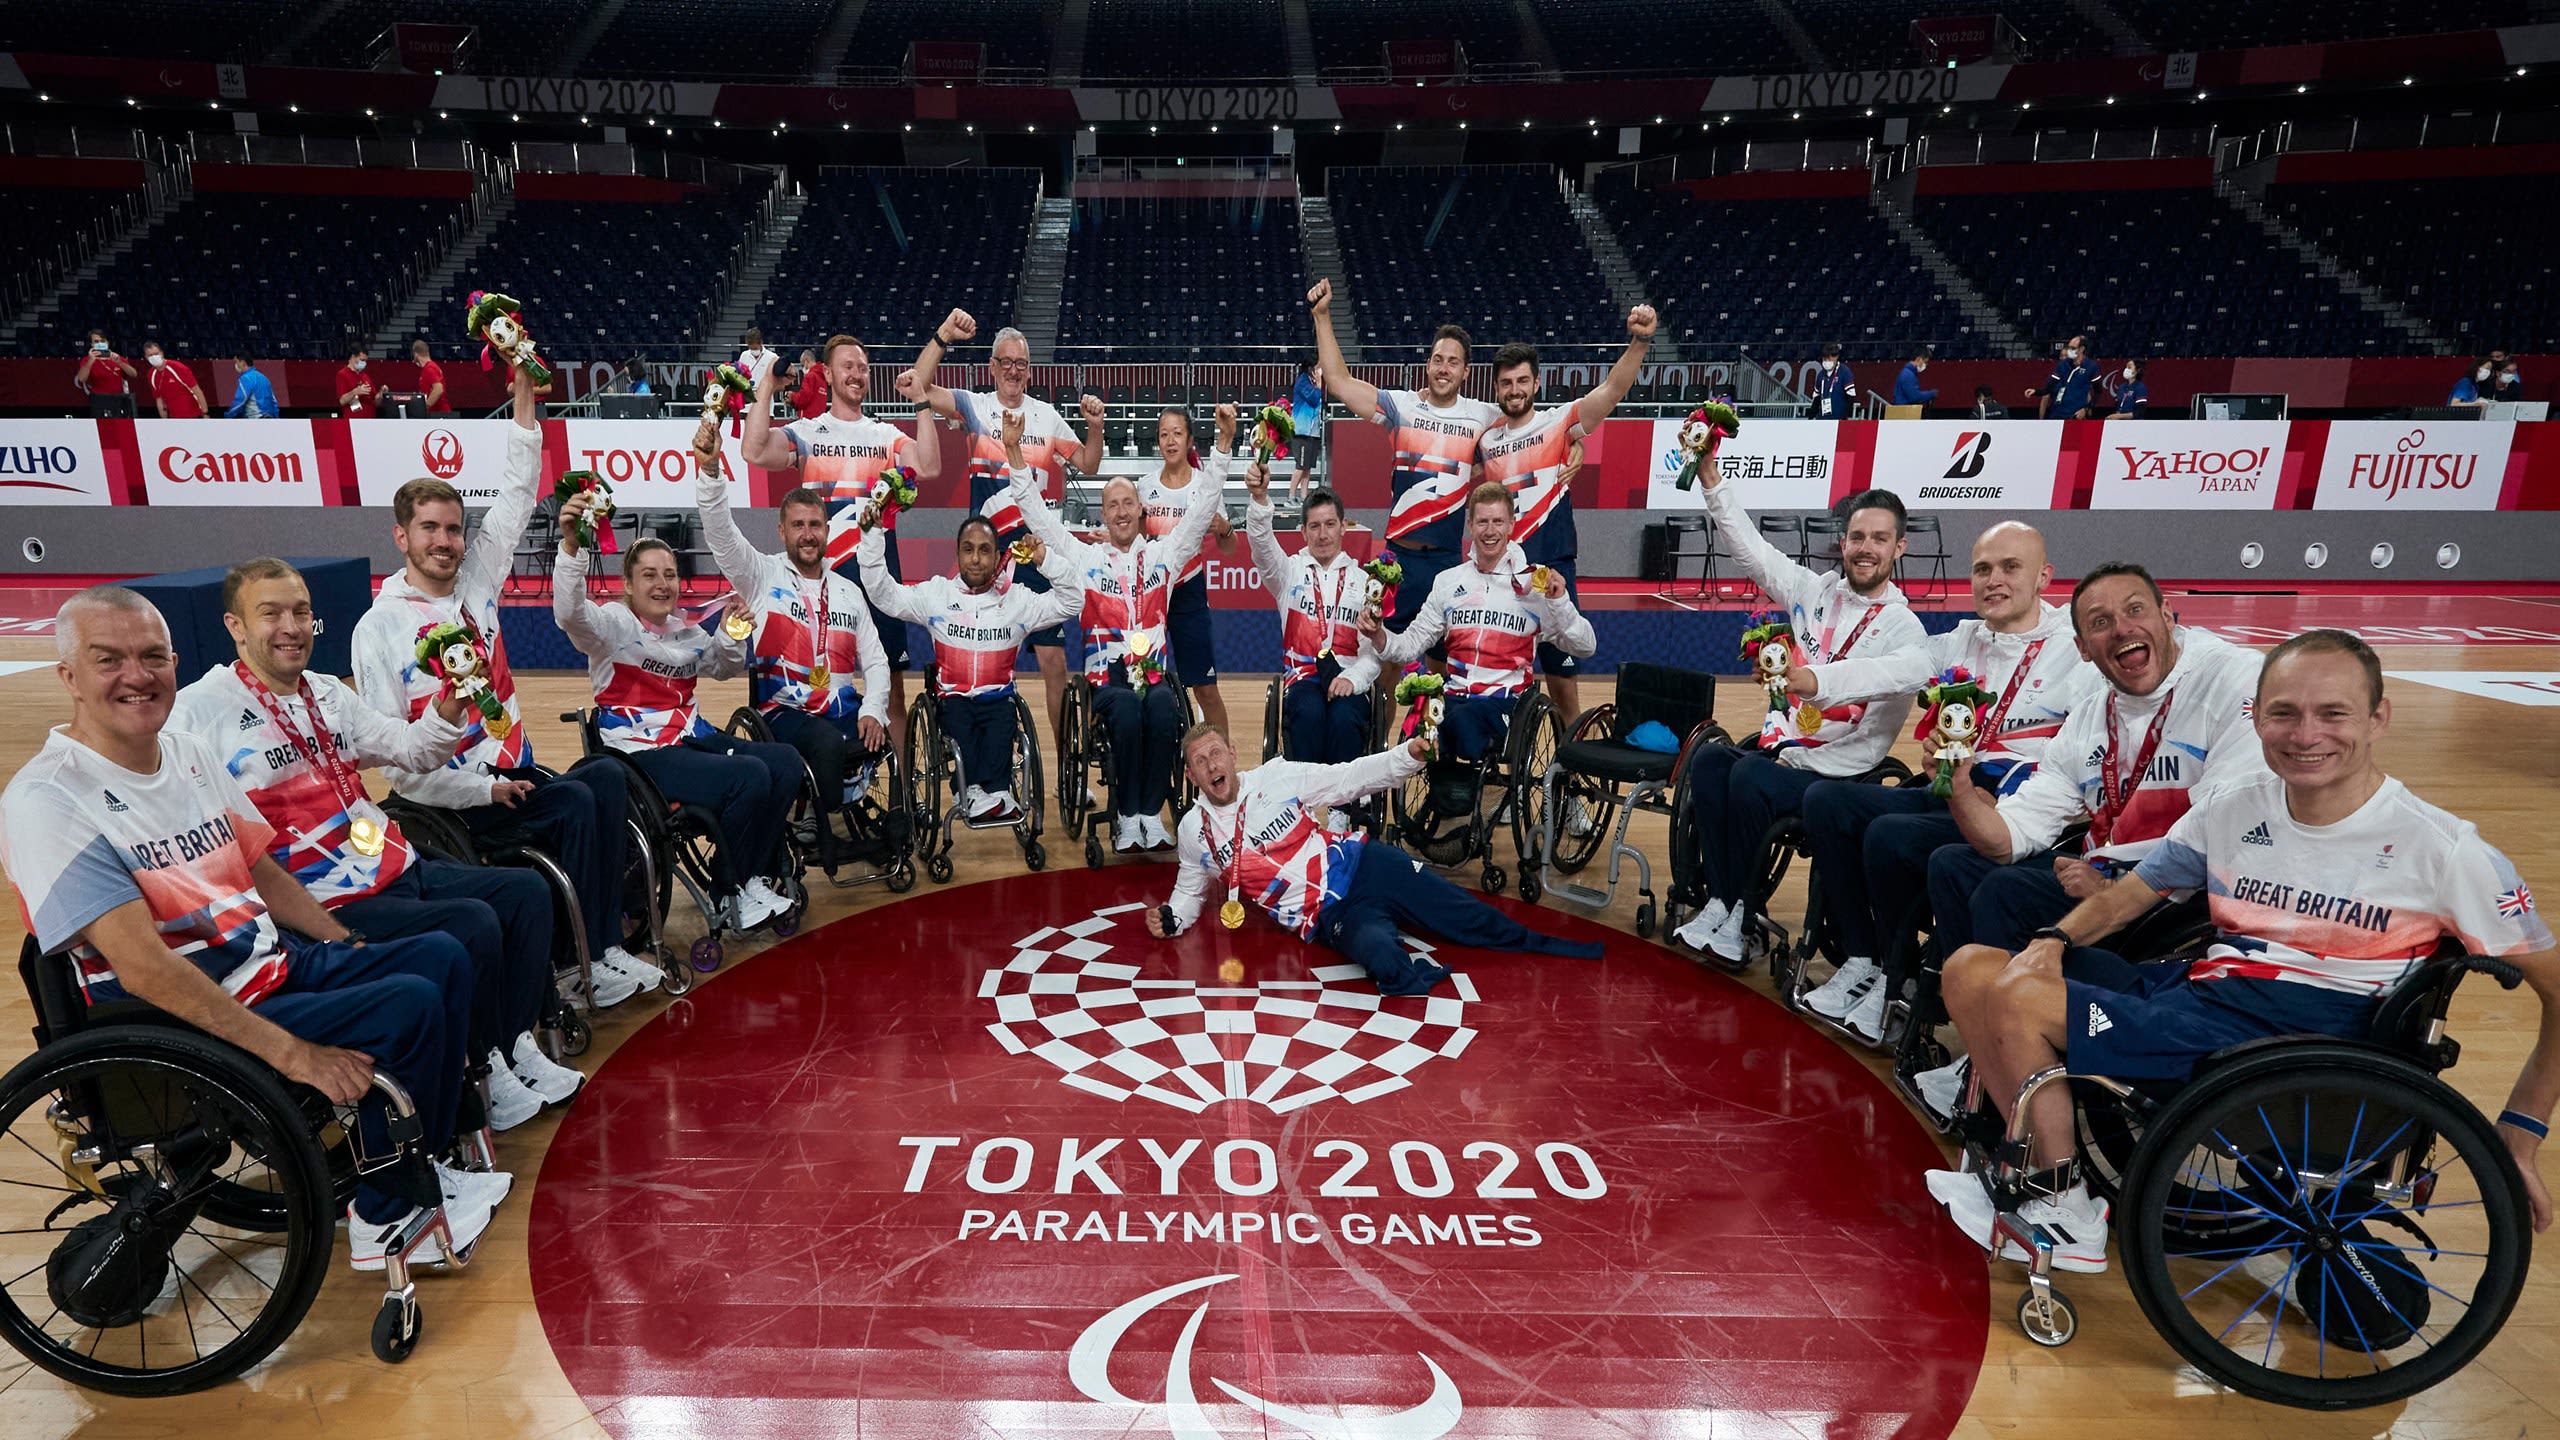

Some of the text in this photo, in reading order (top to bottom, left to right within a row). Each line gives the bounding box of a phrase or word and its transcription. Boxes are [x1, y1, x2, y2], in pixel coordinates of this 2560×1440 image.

[222, 66, 239, 85] 北
[2171, 56, 2191, 76] 北
[478, 76, 678, 114] TOKYO 2020
[1752, 67, 1959, 109] TOKYO 2020
[1114, 87, 1299, 121] TOKYO 2020
[1413, 418, 1441, 433] GREAT
[1443, 423, 1475, 439] BRITAIN
[812, 443, 888, 460] GREAT BRITAIN
[1512, 433, 1544, 452] BRITAIN
[158, 447, 303, 483] Canon
[436, 465, 457, 473] JAL
[2115, 446, 2271, 480] YAHOO!
[2198, 476, 2258, 494] JAPAN
[2347, 453, 2479, 501] FUJITSU
[1918, 487, 2004, 499] BRIDGESTONE
[947, 623, 1012, 641] GREAT BRITAIN
[1452, 609, 1527, 633] GREAT BRITAIN
[641, 658, 676, 676] GREAT
[240, 720, 265, 732] adidas
[264, 742, 302, 770] GREA
[330, 758, 352, 798] TOKYO 2020
[2241, 835, 2273, 847] adidas
[2233, 876, 2393, 933] GREAT BRITAIN
[2089, 1003, 2097, 1037] adidas
[898, 1136, 1609, 1200] TOKYO 2020
[957, 1209, 1543, 1247] PARALYMPIC GAMES
